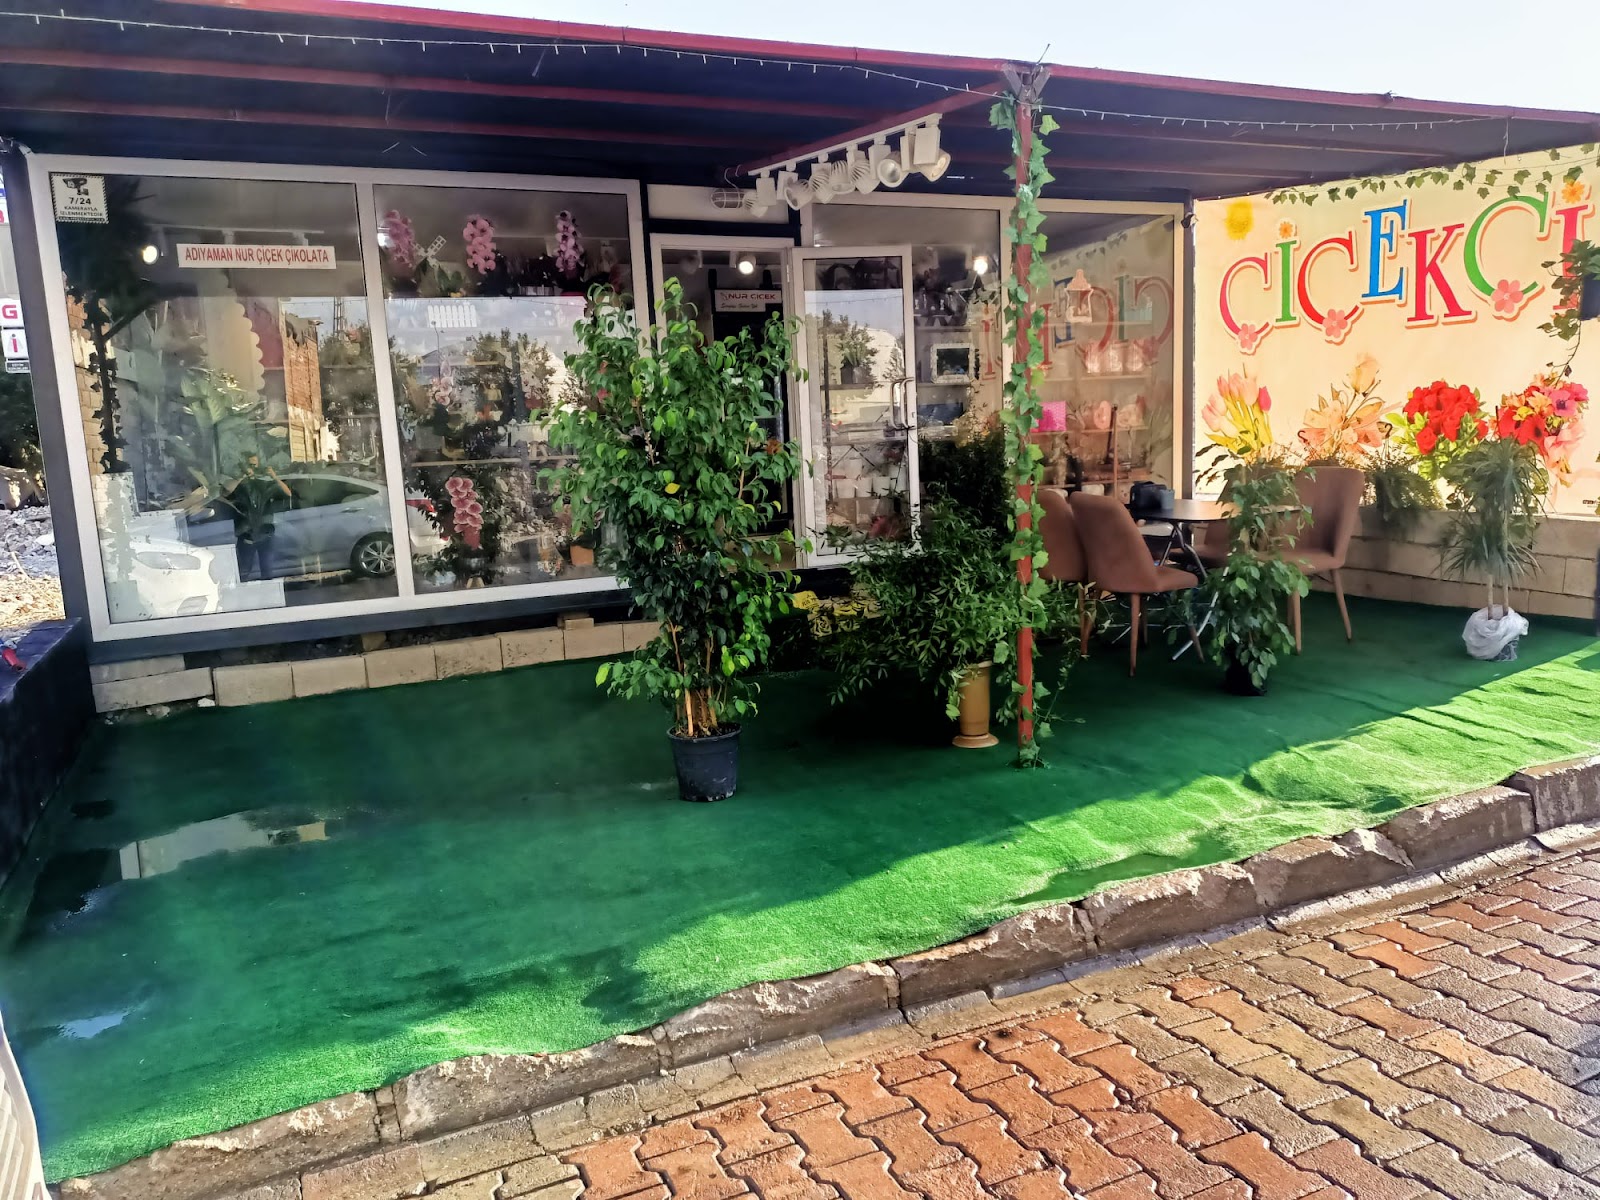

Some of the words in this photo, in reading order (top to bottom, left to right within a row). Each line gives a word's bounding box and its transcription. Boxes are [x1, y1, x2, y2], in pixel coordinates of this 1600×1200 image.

[68, 196, 92, 205] 7/24
[185, 247, 234, 262] ADIYAMAN
[235, 248, 255, 262] NUR
[728, 292, 748, 300] NUR
